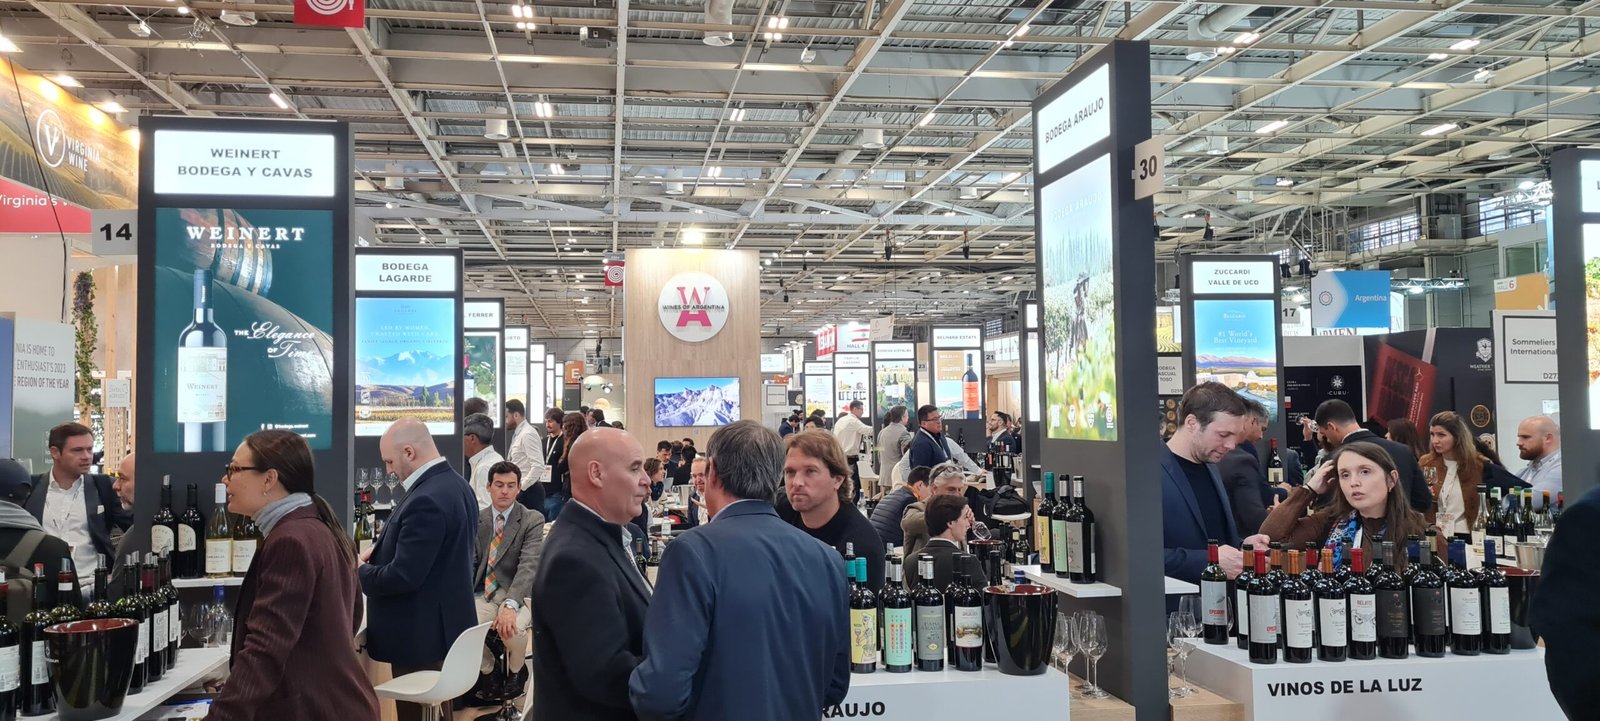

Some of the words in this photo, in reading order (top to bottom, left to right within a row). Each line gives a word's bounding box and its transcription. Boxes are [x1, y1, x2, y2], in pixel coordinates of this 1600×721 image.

[1045, 117, 1072, 144] BODEGA
[1074, 97, 1104, 126] ARAUJO
[66, 135, 100, 162] VIRGINIA
[210, 148, 280, 160] WEINERT
[68, 151, 88, 172] WINE
[1139, 155, 1158, 180] 30
[178, 166, 242, 176] BODEGA
[246, 166, 257, 177] Y
[262, 168, 313, 178] CAVAS
[100, 222, 132, 240] 14
[186, 226, 305, 241] WEINERT
[382, 262, 429, 271] BODEGA
[378, 274, 432, 283] LAGARDE
[1508, 280, 1514, 289] 6
[1355, 294, 1387, 303] Argentina
[1282, 308, 1296, 316] 17
[248, 321, 315, 344] Elegance
[1229, 337, 1258, 345] Vineyard
[27, 344, 32, 354] IS
[33, 344, 48, 356] HOME
[48, 346, 55, 356] TO
[17, 360, 54, 373] ENTHUSIAST'S
[54, 363, 66, 373] 2023
[572, 368, 580, 378] E
[17, 376, 38, 388] REGION
[38, 378, 45, 388] OF
[45, 379, 56, 388] THE
[56, 380, 69, 389] YEAR
[1267, 680, 1325, 697] VINOS
[1330, 680, 1354, 694] DE
[1359, 679, 1382, 693] LA
[1389, 678, 1423, 692] LUZ
[821, 702, 886, 719] RAUJO
